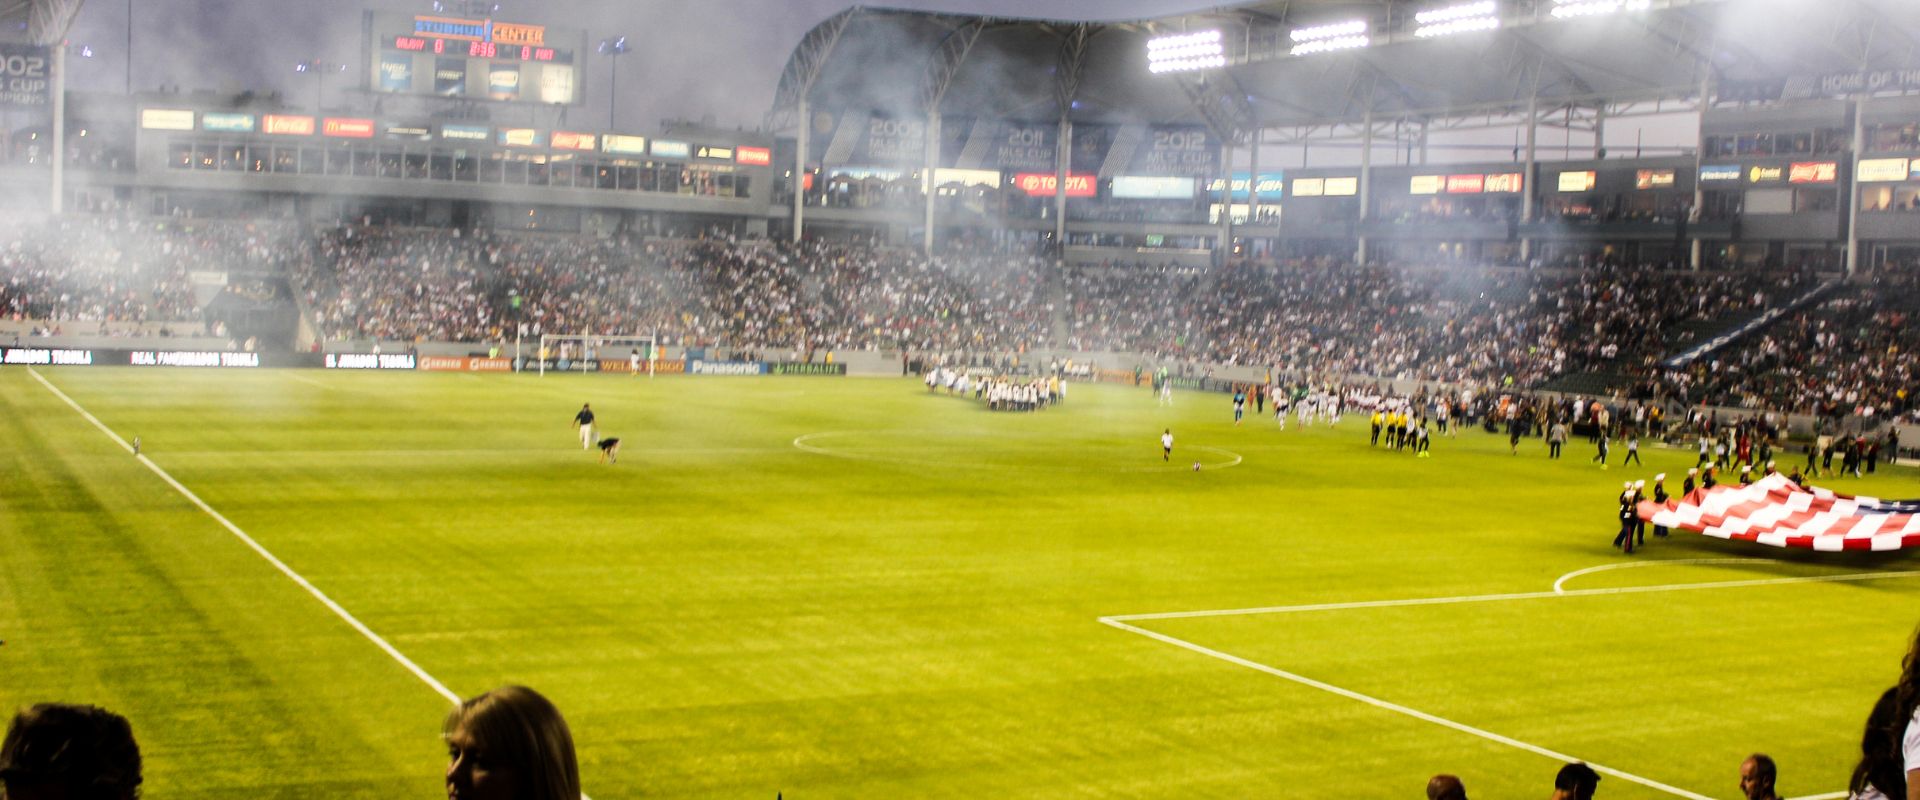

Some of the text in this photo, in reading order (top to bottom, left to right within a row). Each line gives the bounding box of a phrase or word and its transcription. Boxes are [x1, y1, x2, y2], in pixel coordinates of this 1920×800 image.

[492, 26, 544, 44] CENTER
[434, 38, 445, 54] 0
[521, 46, 531, 61] 0
[10, 79, 45, 92] CUP
[1822, 73, 1865, 91] HOME
[1869, 71, 1893, 88] OF
[1008, 128, 1044, 147] 2011
[1153, 130, 1206, 151] 2012
[999, 146, 1052, 161] MLS CUP
[1147, 151, 1213, 165] MLS CUP
[1041, 176, 1088, 191] TOOTA
[692, 360, 760, 375] Panasonic
[786, 361, 840, 374] HERBALIFE
